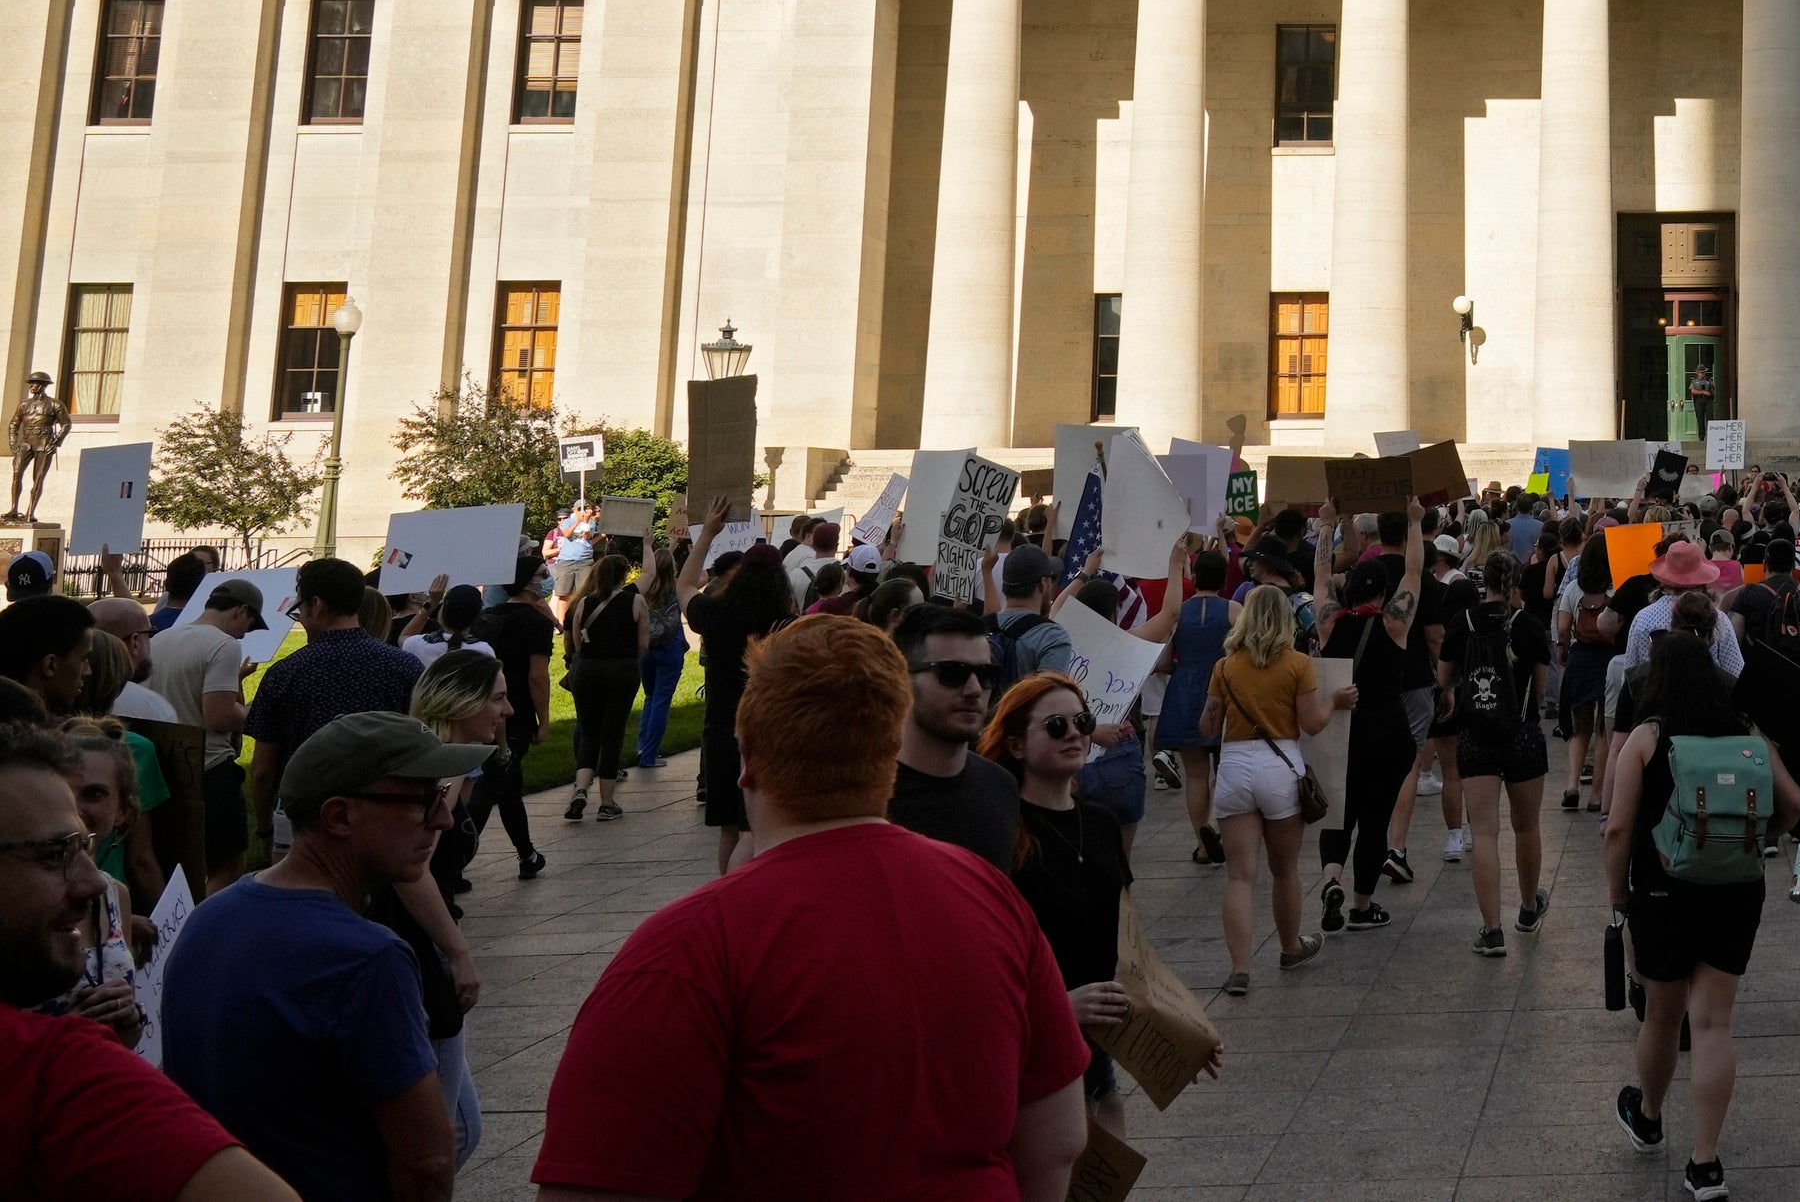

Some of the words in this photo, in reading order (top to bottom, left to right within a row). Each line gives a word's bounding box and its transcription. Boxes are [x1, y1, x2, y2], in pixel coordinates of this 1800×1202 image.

[1726, 422, 1743, 431] HER
[1726, 433, 1742, 441] HER
[1726, 443, 1742, 452] HER
[1725, 454, 1741, 462] HER
[1232, 477, 1254, 493] MY
[938, 542, 975, 571] RIGHTS
[935, 571, 975, 598] MULTIPLY
[1475, 701, 1498, 711] Rugby
